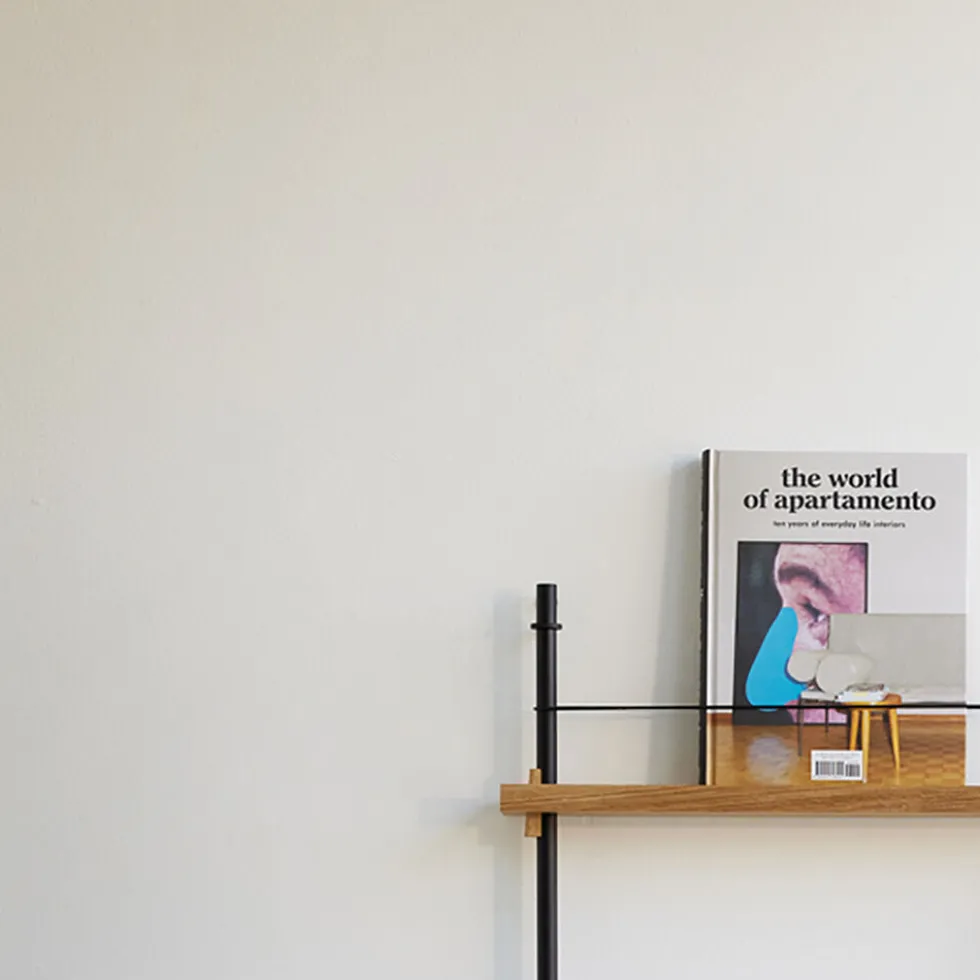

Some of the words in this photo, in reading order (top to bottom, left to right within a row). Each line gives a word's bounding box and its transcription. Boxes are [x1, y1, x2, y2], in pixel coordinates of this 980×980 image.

[781, 467, 821, 488] the
[828, 467, 898, 488] world
[743, 489, 769, 510] of
[774, 490, 936, 513] apartamento
[773, 520, 786, 528] ten
[788, 521, 809, 529] years
[811, 520, 820, 528] of
[821, 520, 857, 529] everyday
[859, 520, 871, 528] life
[873, 520, 906, 528] interiors
